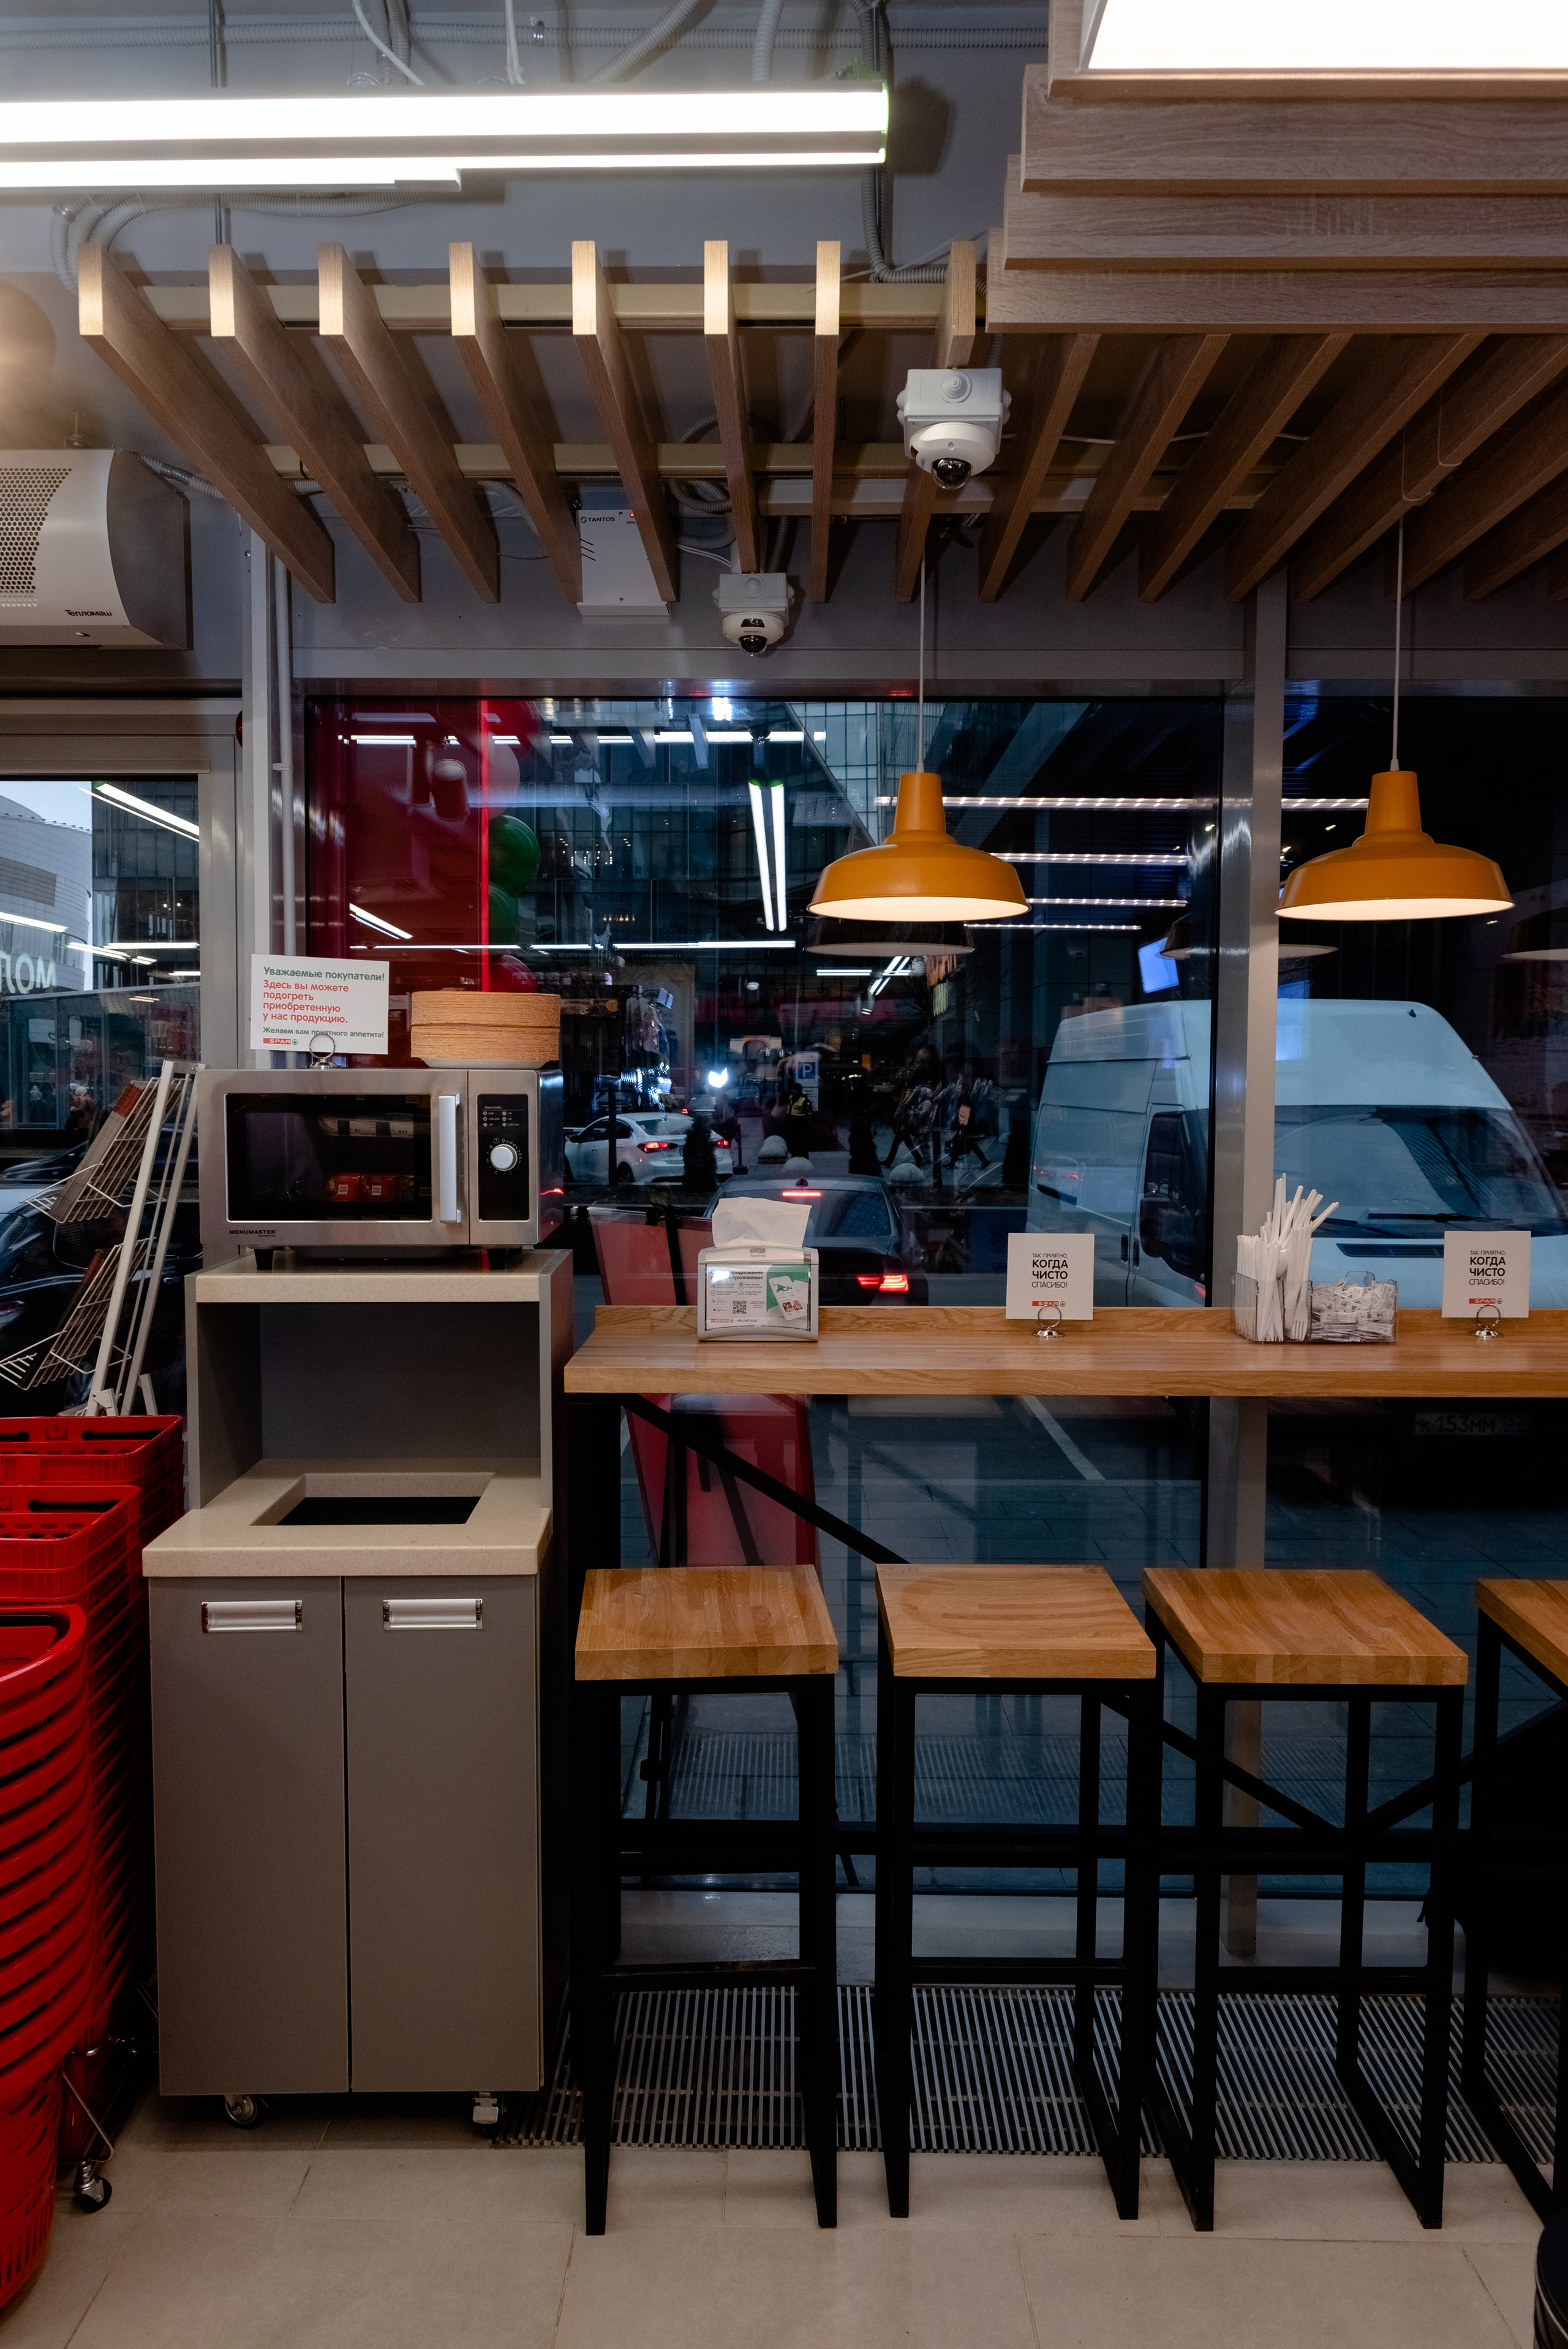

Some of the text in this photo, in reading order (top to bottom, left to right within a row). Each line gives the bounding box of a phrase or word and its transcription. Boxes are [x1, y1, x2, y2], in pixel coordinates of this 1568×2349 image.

[264, 966, 385, 982] Уважаемые покупатели!
[263, 980, 292, 989] Здесь
[263, 991, 314, 1003] подогреть
[263, 1002, 341, 1013] приобретенную
[290, 1014, 348, 1024] продукцию.
[1032, 1260, 1068, 1269] КОГДА
[1470, 1257, 1506, 1266] КОГДА
[1032, 1271, 1068, 1279] ЧИСТО
[1470, 1268, 1506, 1277] ЧИСТО
